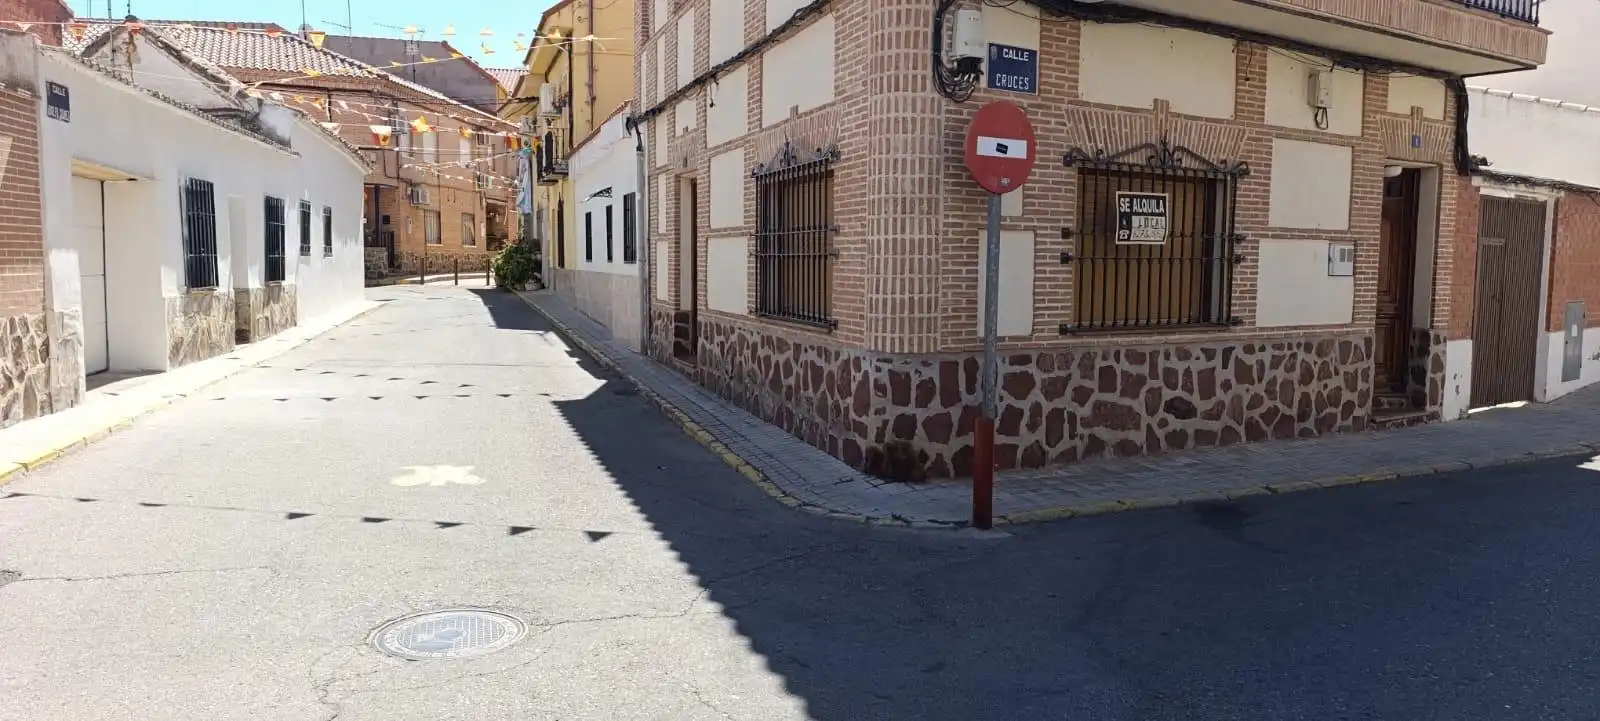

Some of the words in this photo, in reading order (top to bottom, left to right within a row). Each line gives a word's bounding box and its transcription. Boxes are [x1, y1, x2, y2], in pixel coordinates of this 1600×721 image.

[1003, 48, 1029, 62] CALLE
[995, 73, 1029, 90] CRUCES
[52, 85, 66, 97] CALLE
[1119, 197, 1131, 212] SE
[1132, 198, 1165, 214] ALQUILA
